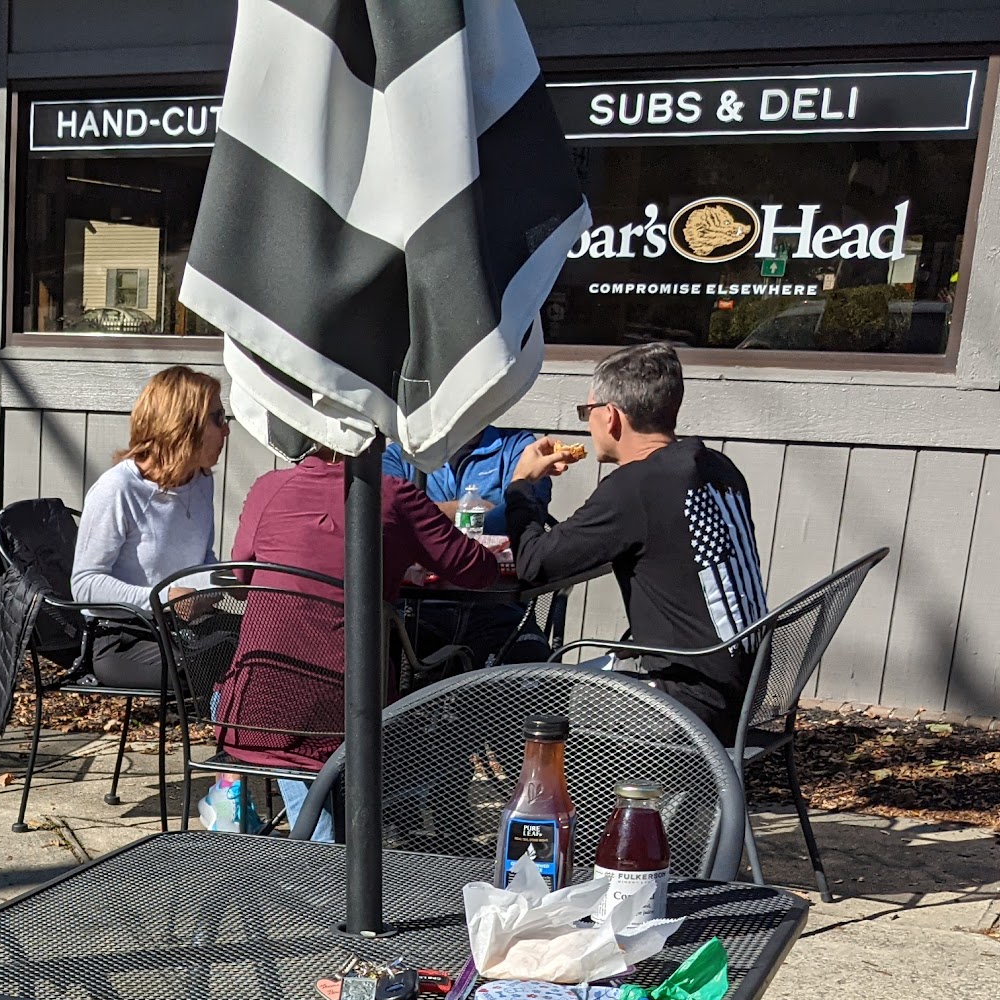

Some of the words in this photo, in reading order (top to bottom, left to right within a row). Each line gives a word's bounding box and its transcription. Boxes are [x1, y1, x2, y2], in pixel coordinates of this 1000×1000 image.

[589, 91, 702, 125] SUBS
[716, 89, 744, 122] &
[759, 86, 859, 121] DELI
[57, 106, 222, 139] HAND-CUT
[567, 203, 667, 259] oar's
[754, 200, 910, 261] Head
[588, 283, 701, 295] COMPROMISE
[705, 283, 818, 296] ELSEWHERE
[618, 872, 666, 880] FULKERSON
